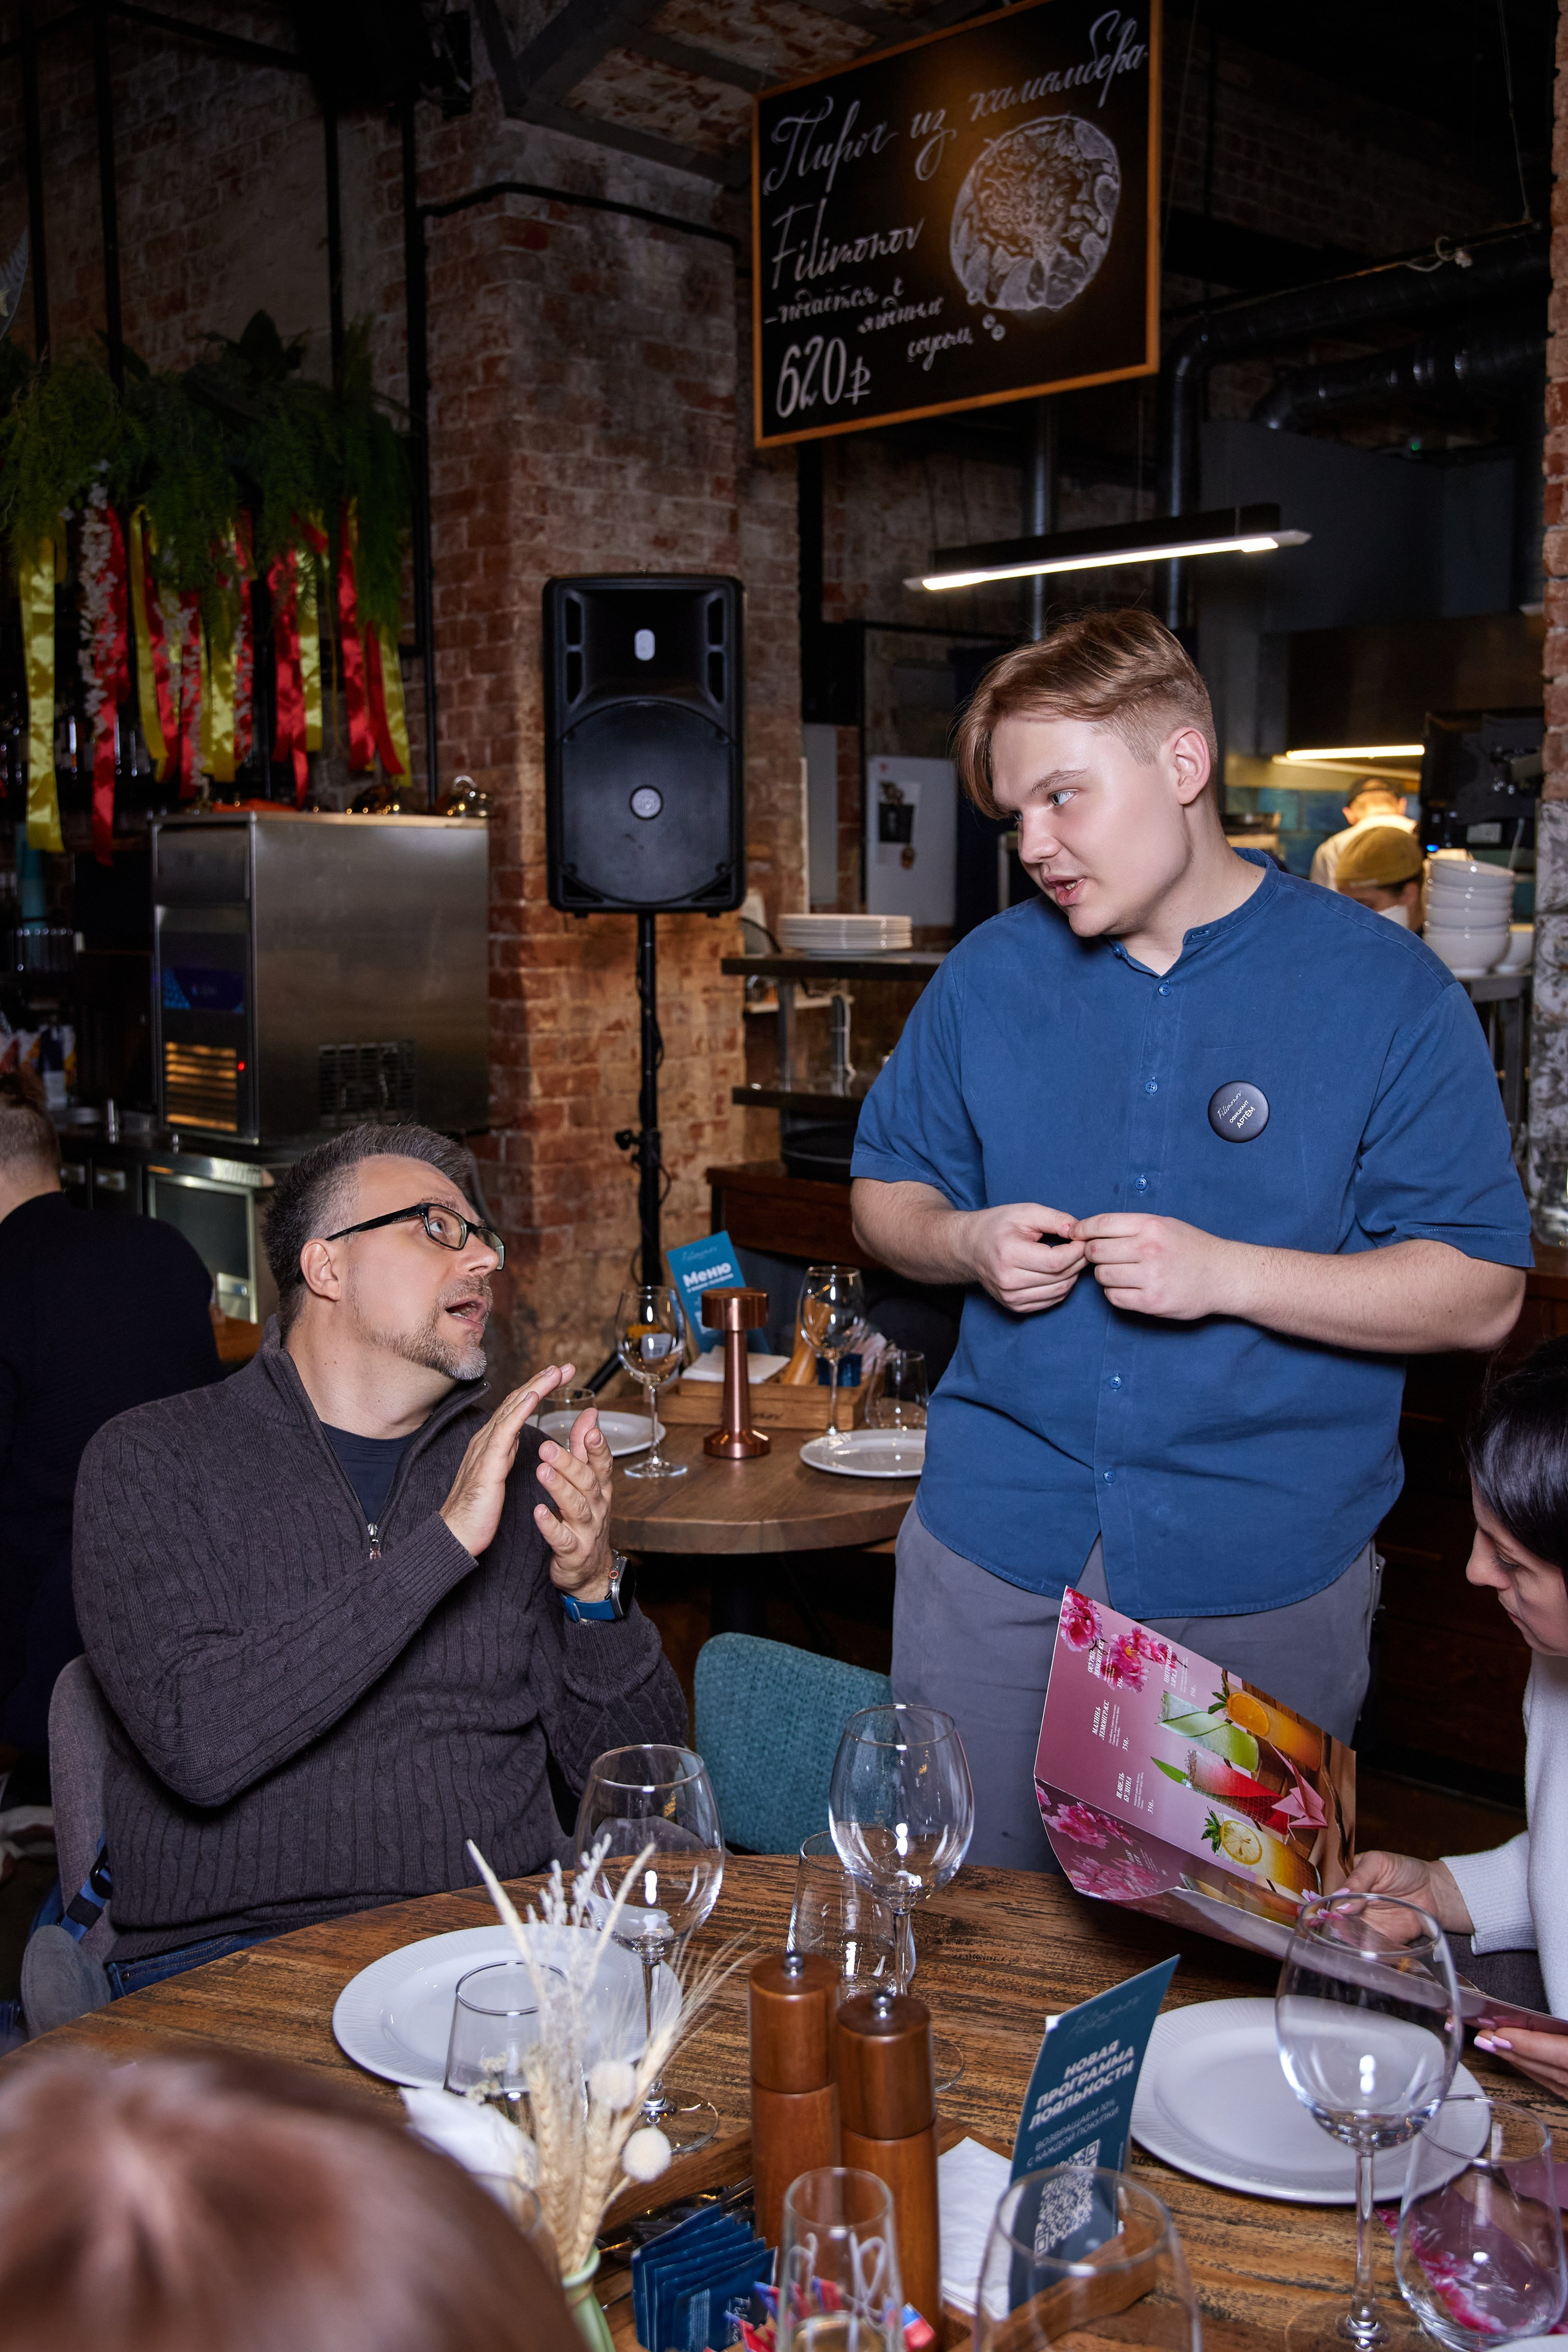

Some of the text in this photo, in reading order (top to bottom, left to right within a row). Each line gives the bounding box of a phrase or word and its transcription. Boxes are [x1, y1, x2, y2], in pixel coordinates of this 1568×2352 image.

[763, 96, 899, 195] Пирог
[911, 109, 956, 181] из
[772, 196, 925, 290] Filimonov
[1217, 1090, 1242, 1120] Filimonov
[1229, 1099, 1249, 1123] ОФИЦИАНТ
[1236, 1106, 1256, 1128] АРТЁМ
[1099, 1700, 1109, 1740] ЛЕМОНГРАСС
[1123, 1776, 1132, 1803] БУЗИНА
[1036, 2046, 1135, 2109] ПРОГРАММА
[1063, 2038, 1120, 2080] НОВАЯ
[1028, 2059, 1135, 2132] ЛОЯЛЬНОСТИ
[1027, 2106, 1119, 2167] С КАЖДОЙ ПОКУПКИ
[1035, 2098, 1116, 2151] ВОЗВРАЩАЕМ 10%
